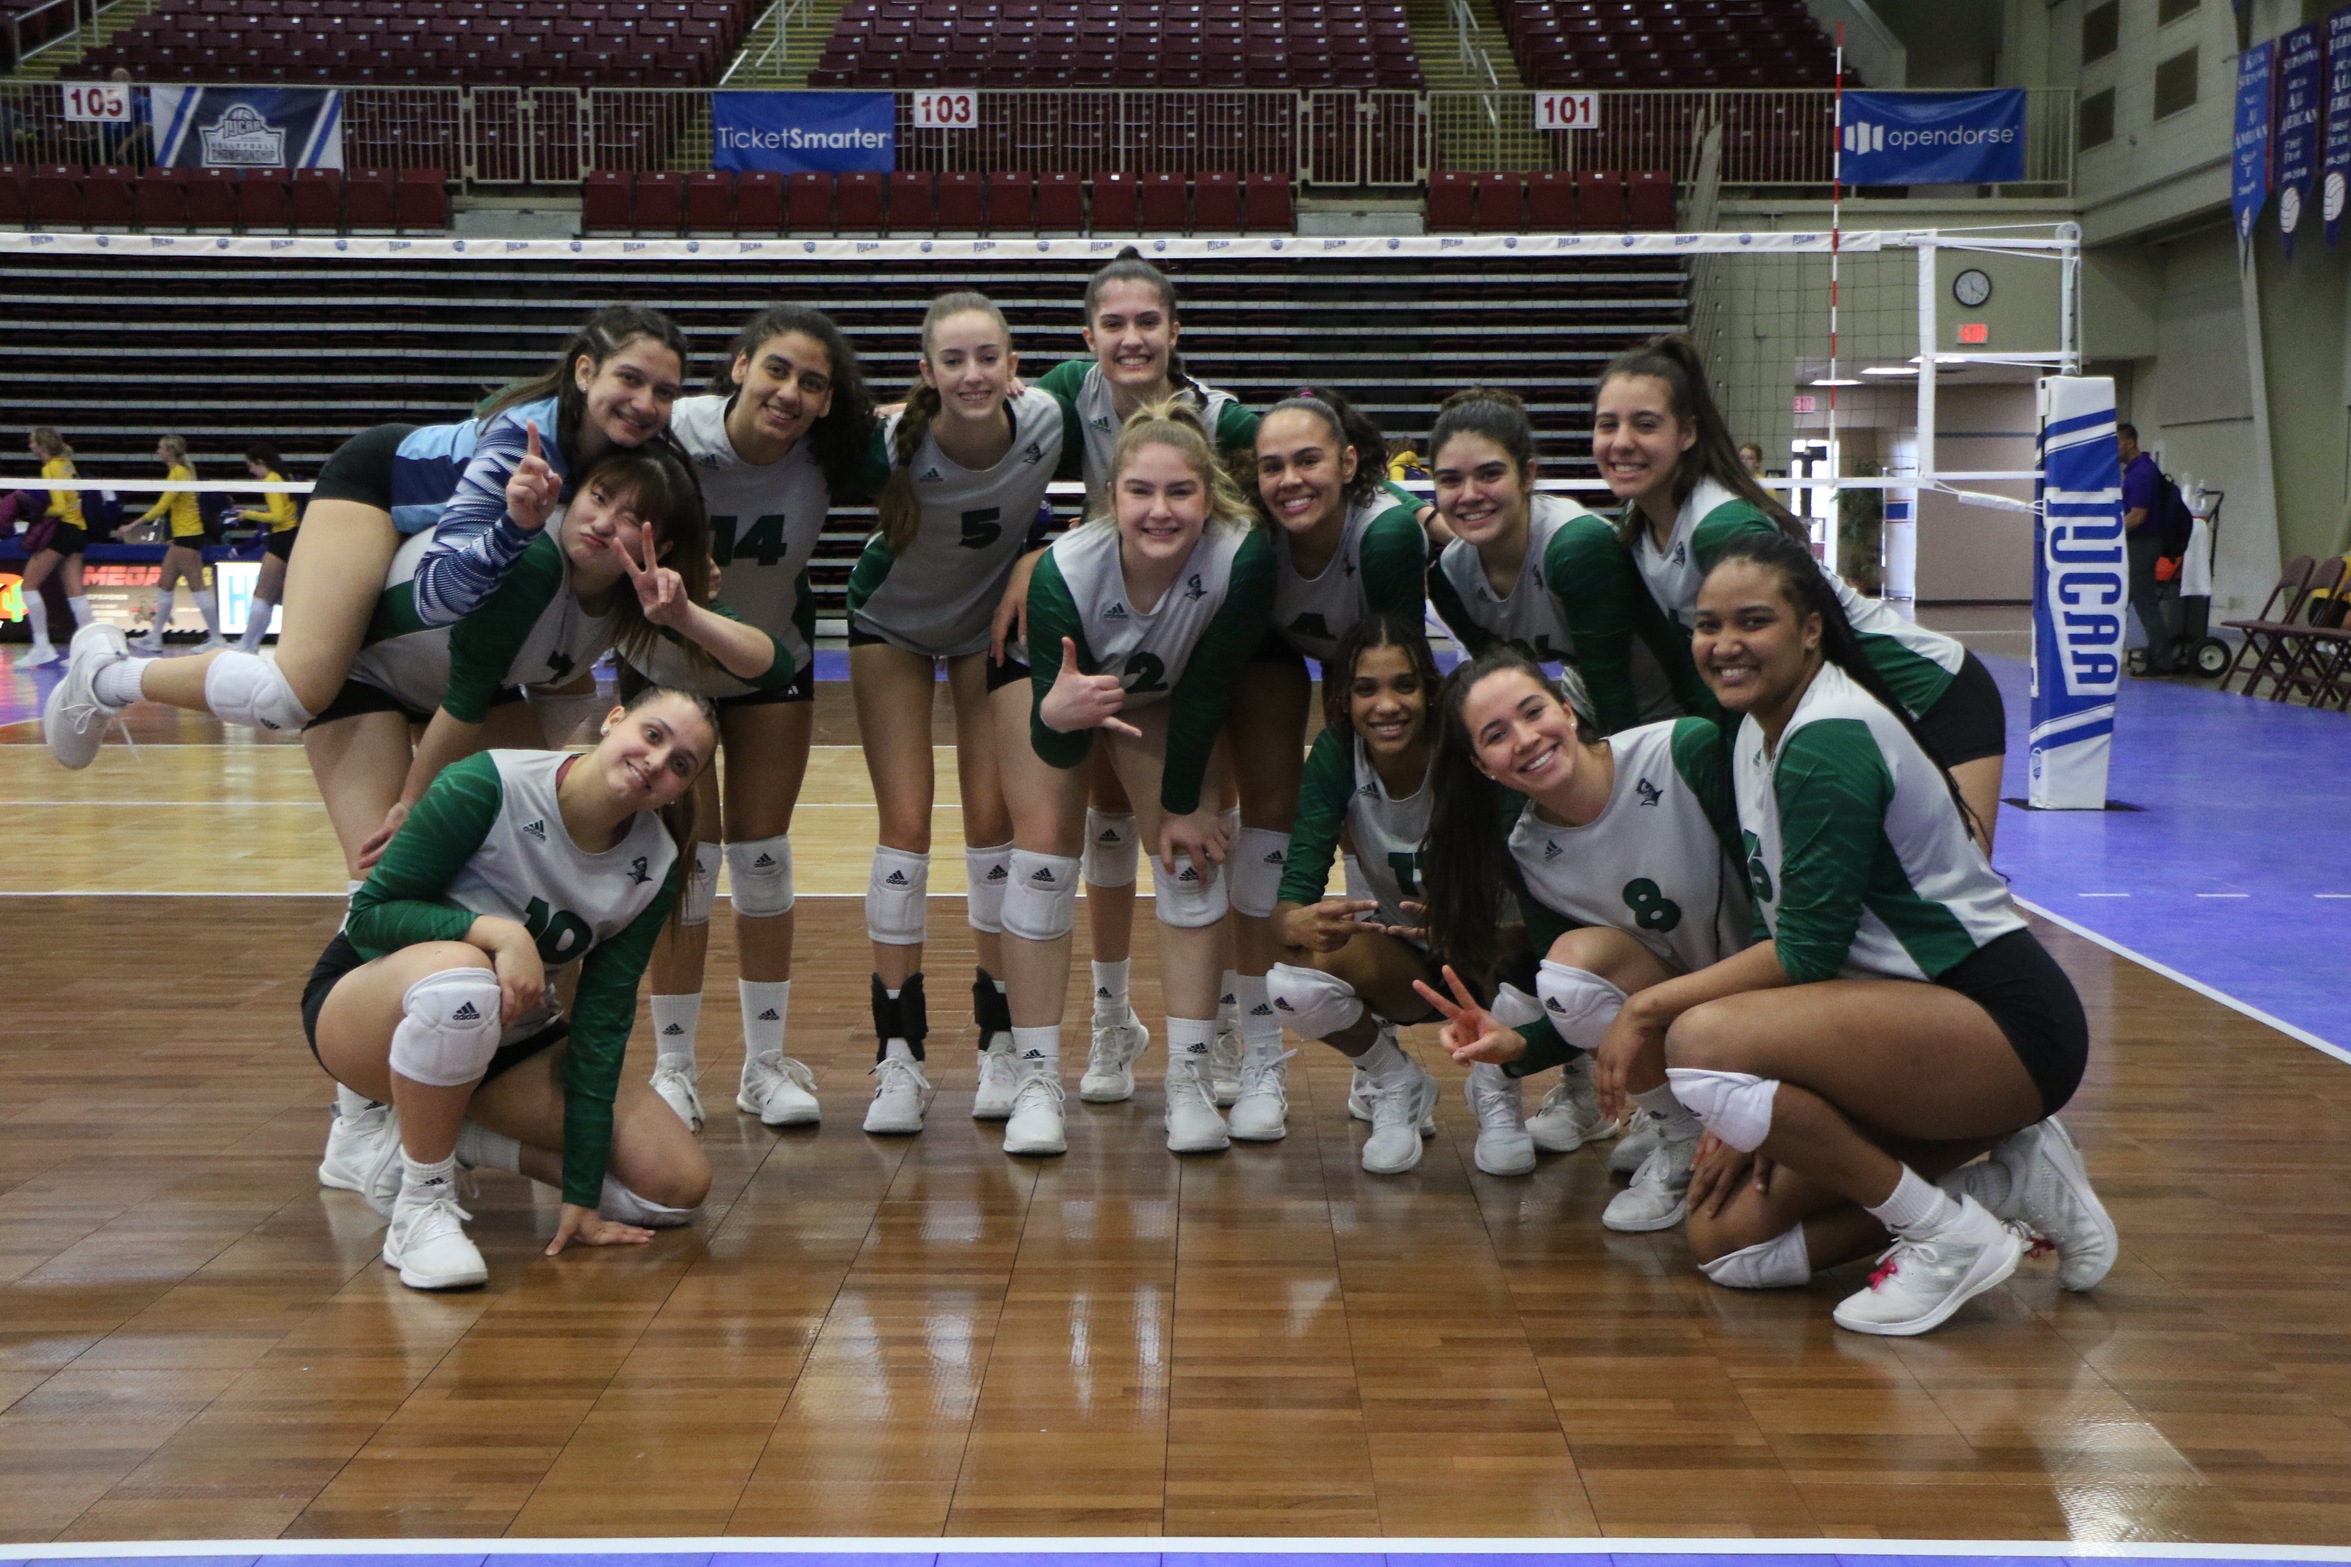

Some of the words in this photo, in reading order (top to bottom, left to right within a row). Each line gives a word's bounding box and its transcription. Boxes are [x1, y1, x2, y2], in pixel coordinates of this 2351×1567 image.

[71, 88, 122, 117] 105
[921, 95, 971, 123] 103
[1544, 96, 1589, 124] 101
[717, 127, 886, 149] TicketSmarter
[1887, 125, 2014, 151] opendorse
[709, 515, 786, 567] 14
[959, 507, 1002, 549] 5
[2044, 497, 2125, 688] NJCAA
[1123, 652, 1169, 694] 2
[1622, 877, 1682, 933] 8
[524, 896, 593, 965] 10
[452, 1013, 480, 1021] adidas
